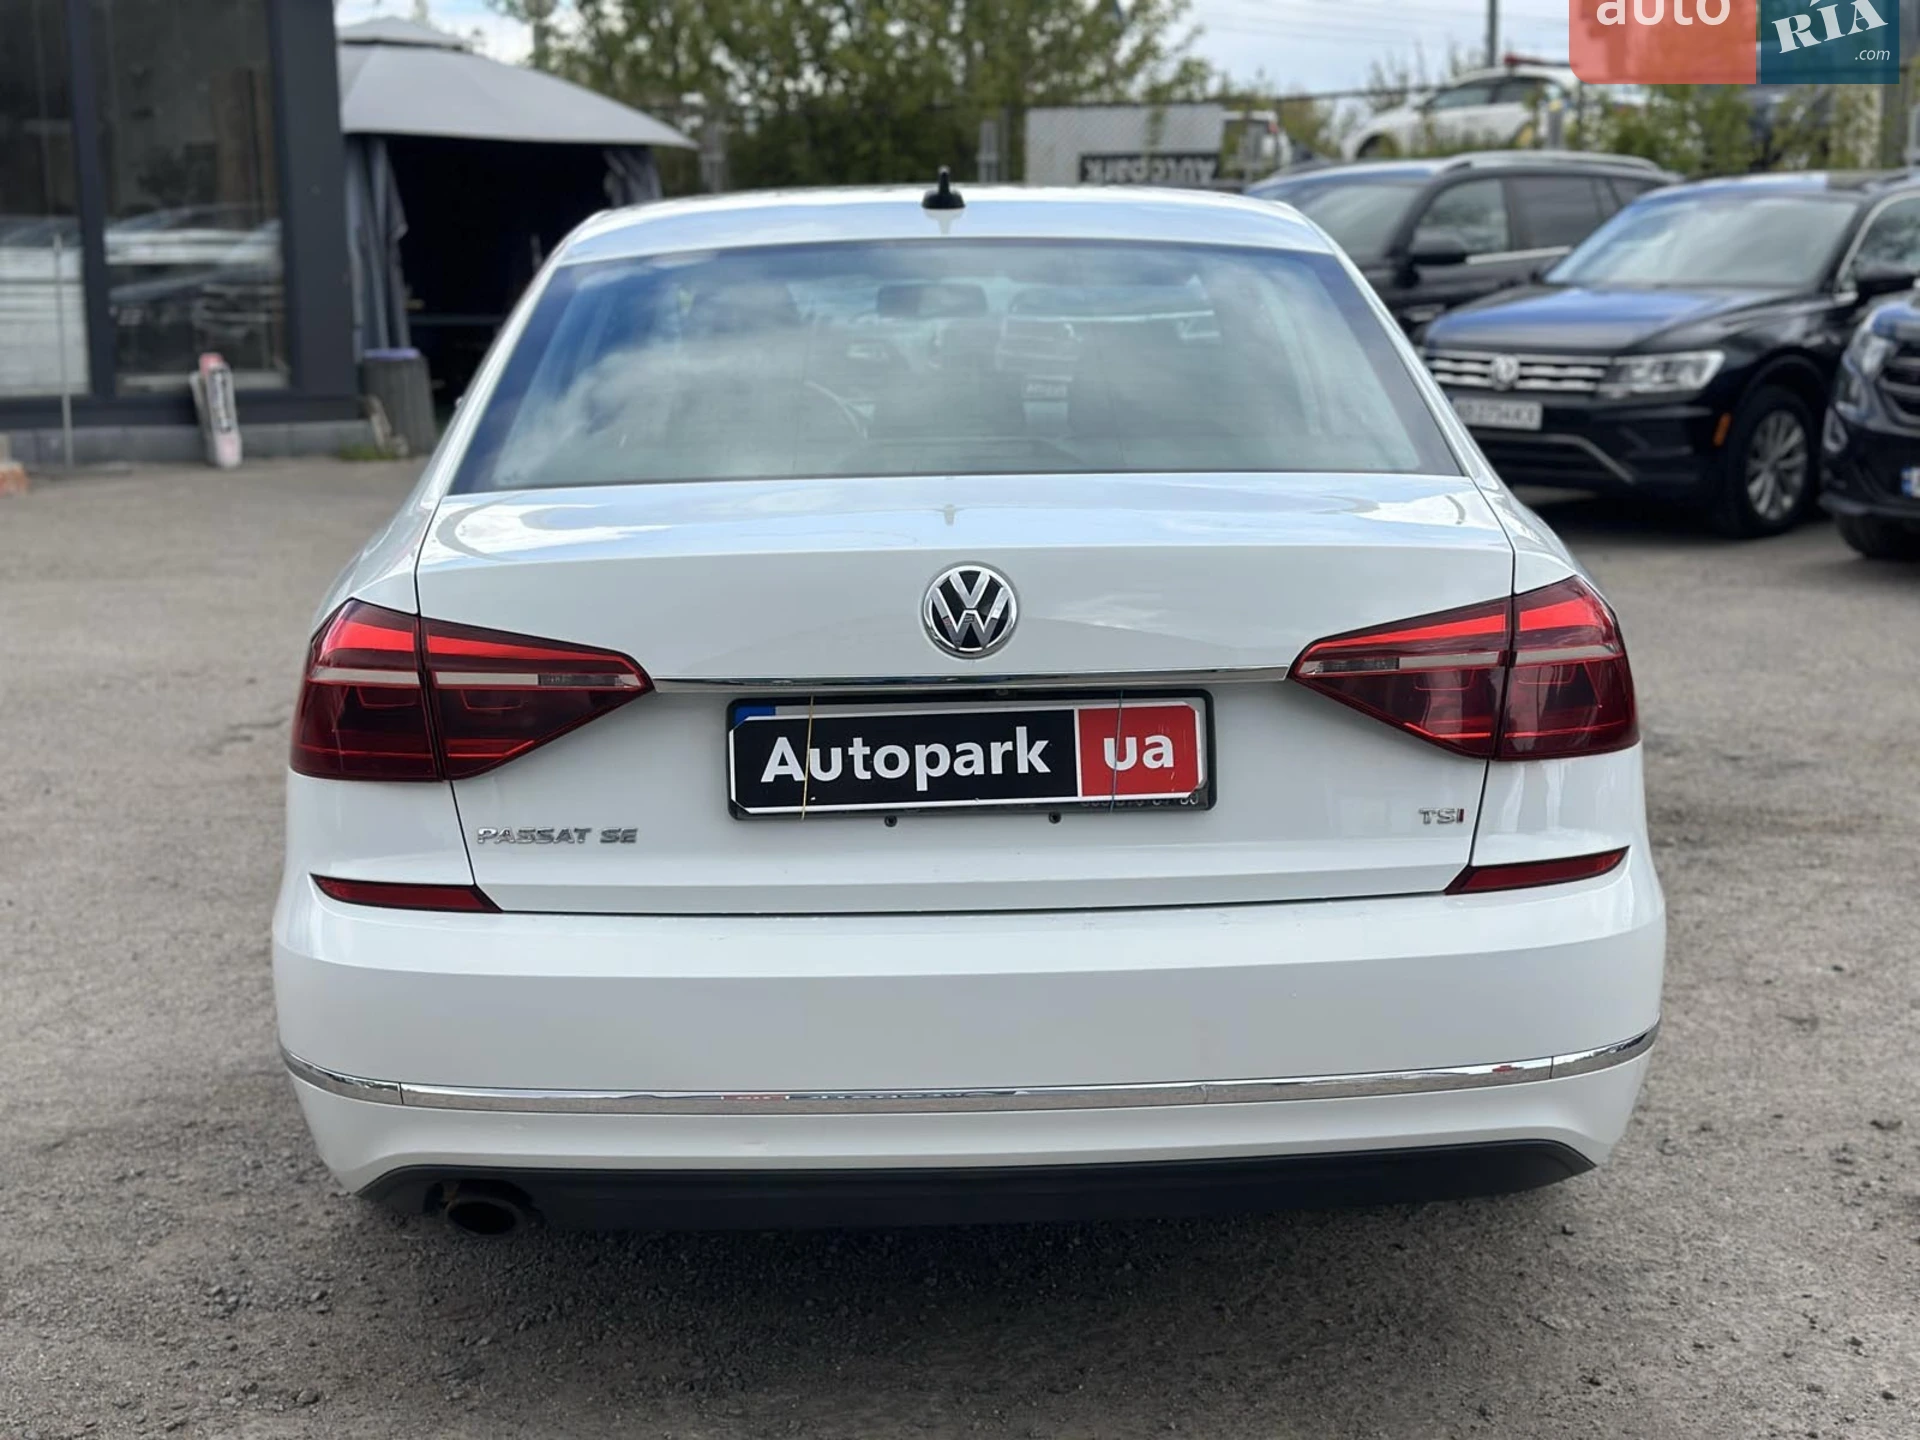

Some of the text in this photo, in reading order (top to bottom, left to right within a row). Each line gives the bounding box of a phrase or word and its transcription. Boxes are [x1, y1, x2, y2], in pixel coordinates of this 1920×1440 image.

[760, 726, 1051, 791] Autopark
[1103, 735, 1175, 769] ua
[1418, 807, 1465, 825] TSI
[476, 826, 639, 845] PASSAT SE
